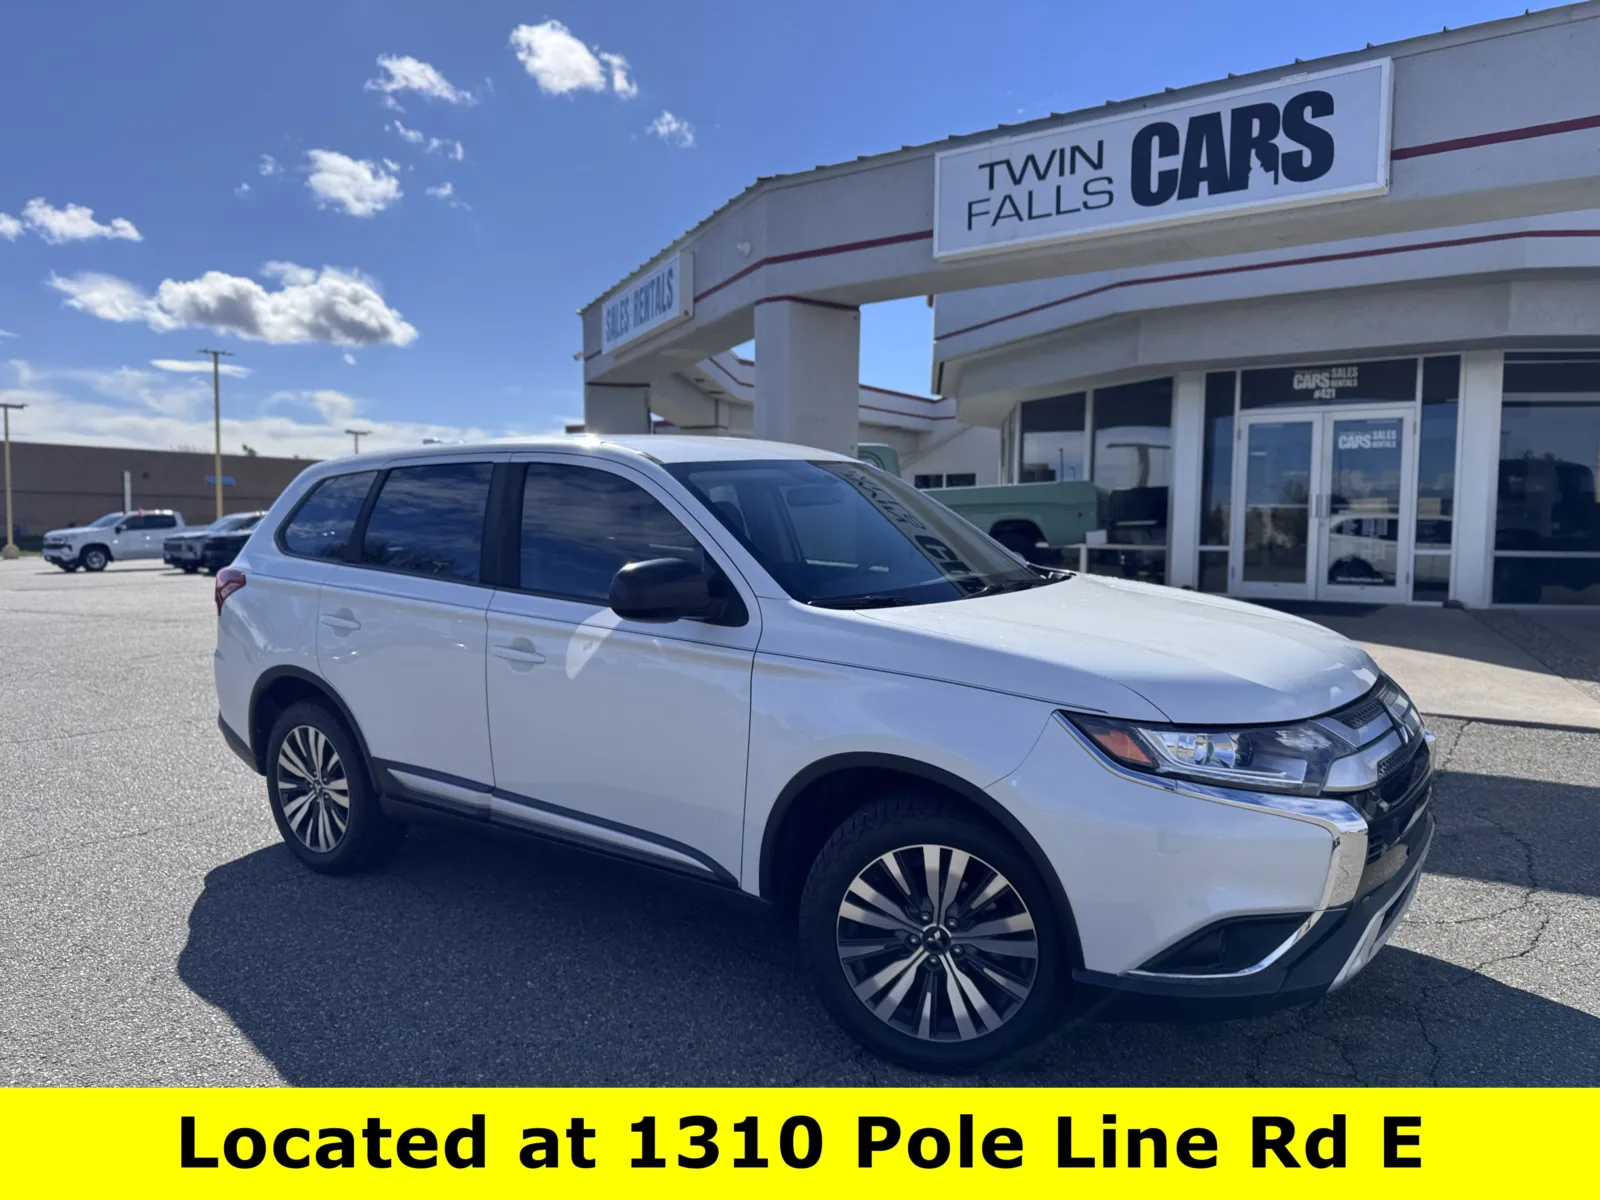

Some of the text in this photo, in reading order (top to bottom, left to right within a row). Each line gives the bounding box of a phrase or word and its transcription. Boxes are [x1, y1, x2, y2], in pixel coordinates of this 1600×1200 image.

[1131, 90, 1334, 207] CARS
[978, 139, 1104, 191] TWIN
[967, 176, 1114, 232] FALLS
[606, 268, 673, 342] SALES RENTALS
[1293, 372, 1330, 390] CARS
[1331, 366, 1358, 378] SALES
[1313, 388, 1336, 399] #421
[1338, 435, 1371, 449] CARS
[1373, 430, 1396, 439] SALES
